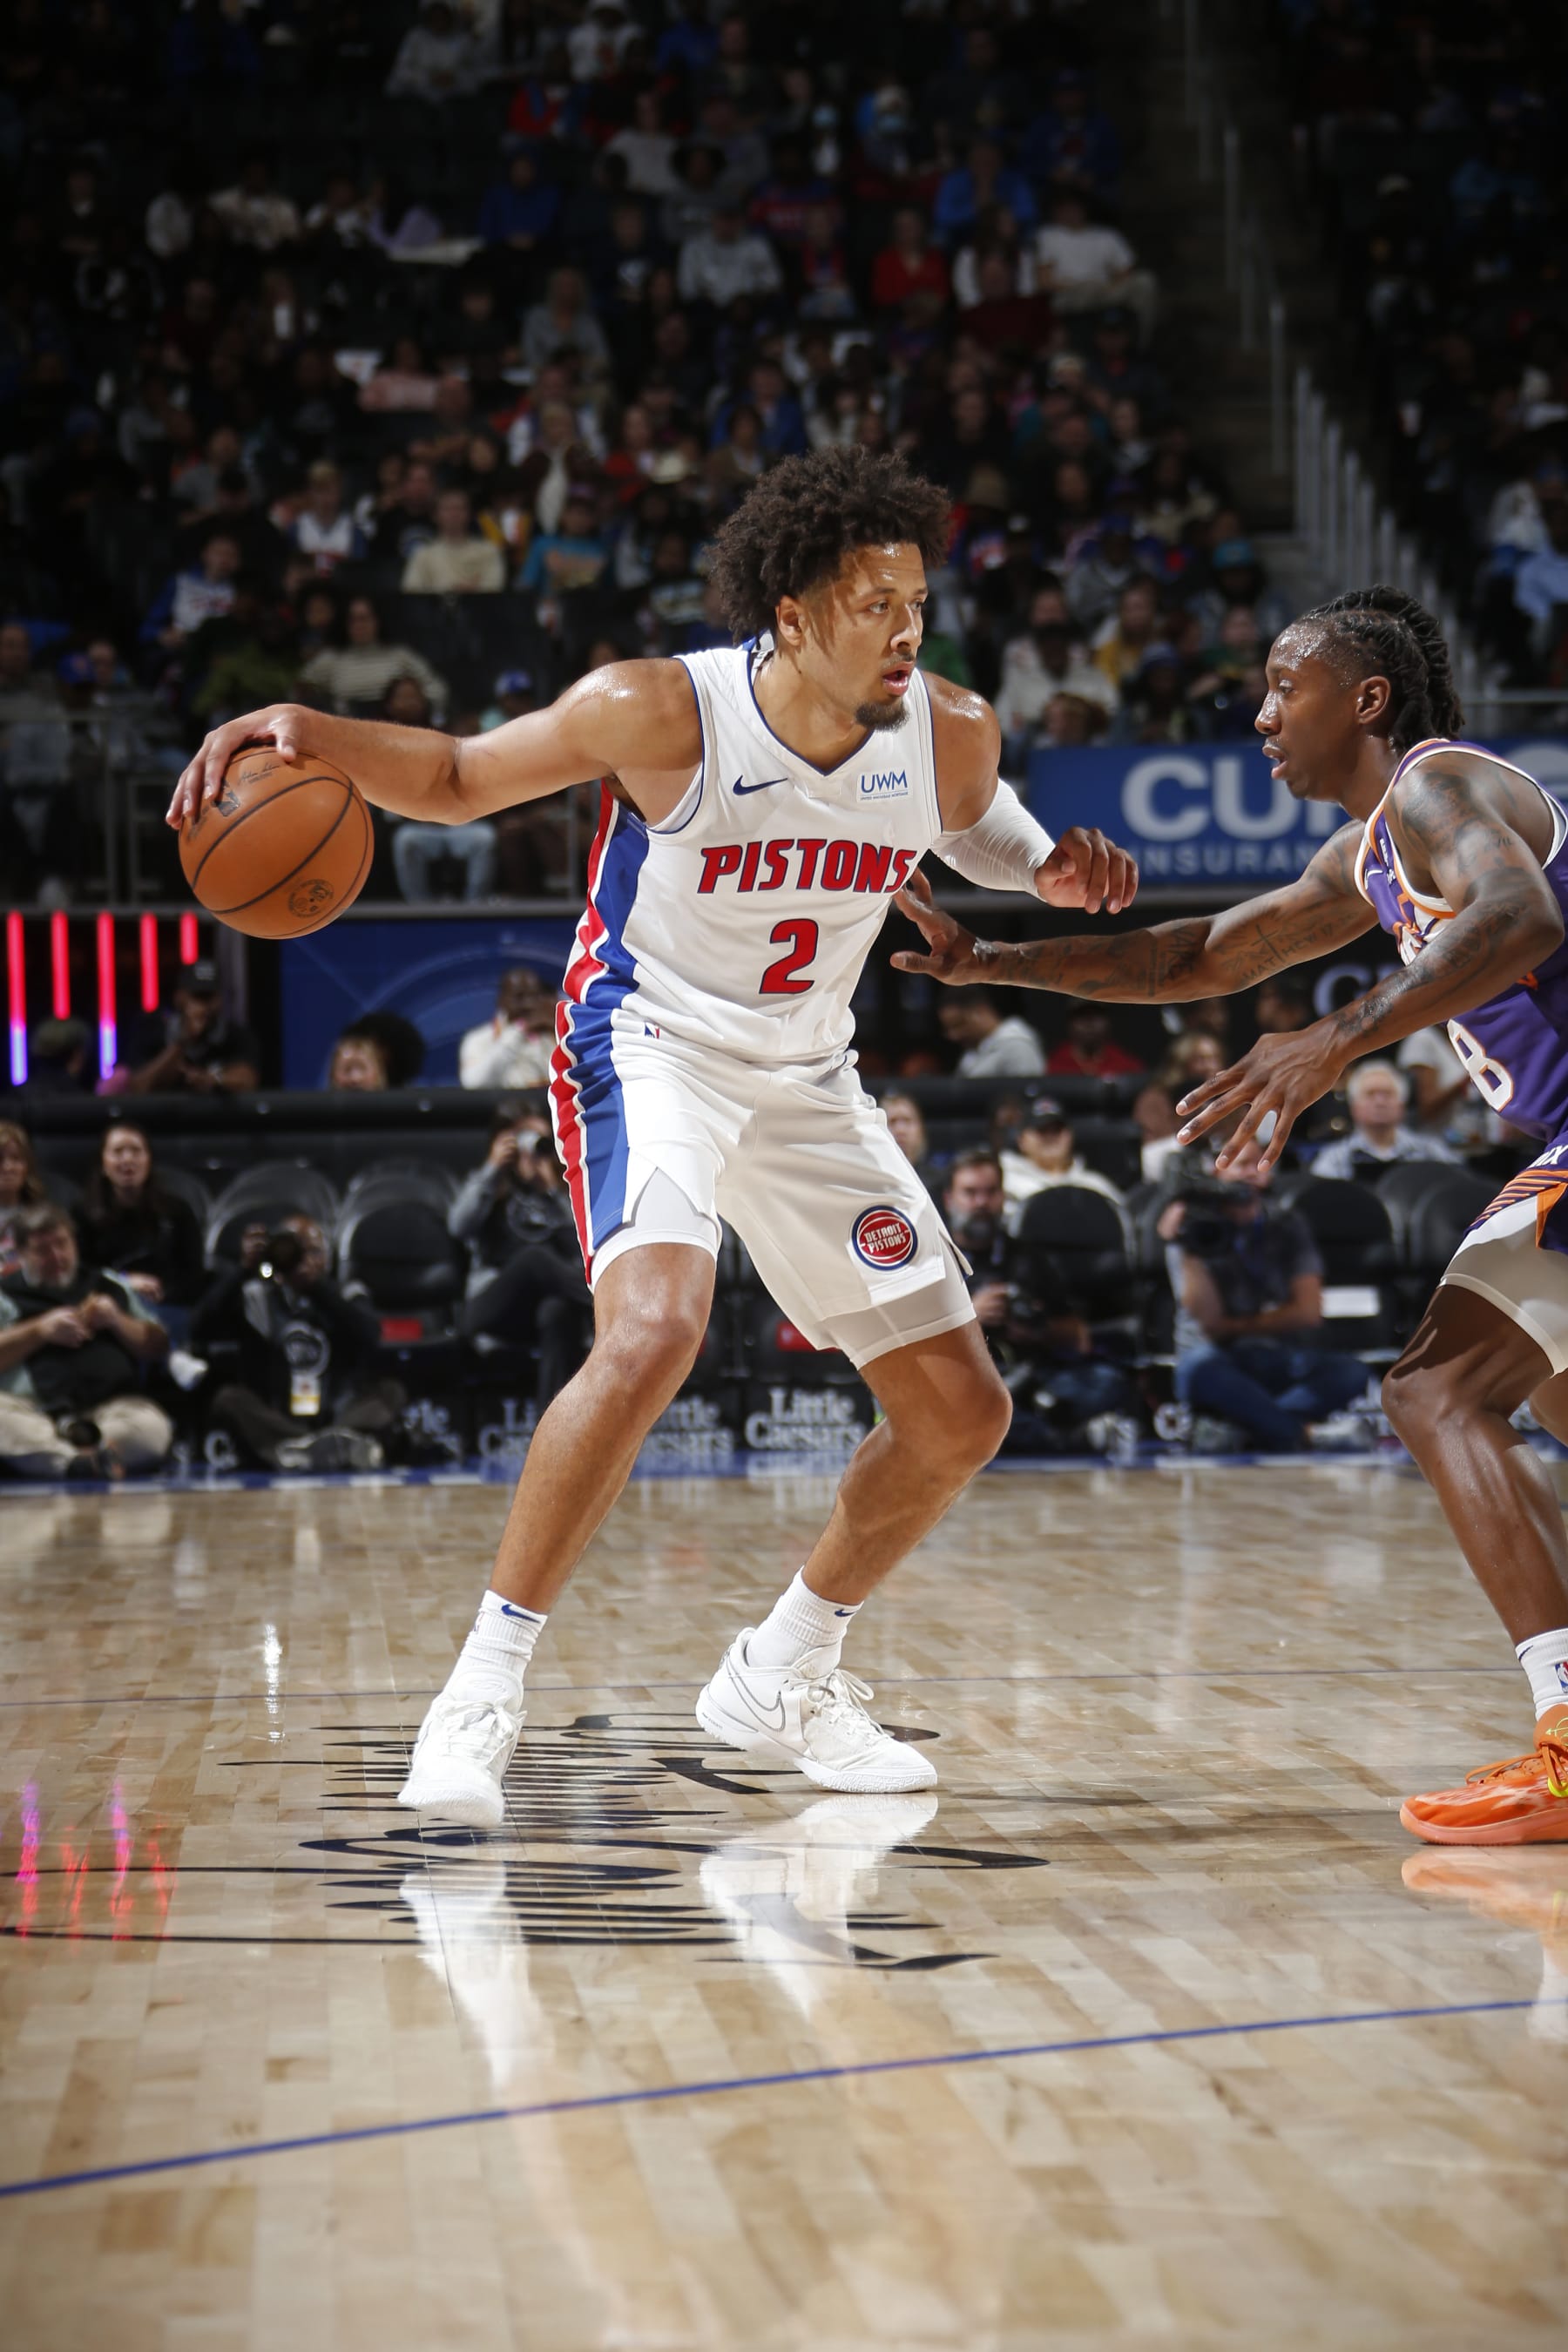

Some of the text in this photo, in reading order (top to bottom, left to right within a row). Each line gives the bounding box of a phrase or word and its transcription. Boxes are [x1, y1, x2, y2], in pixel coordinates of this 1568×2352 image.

[861, 769, 908, 794] UWM
[1121, 754, 1338, 841] CU
[697, 838, 917, 895] PISTONS
[759, 917, 819, 995] 2
[864, 1222, 902, 1243] DETROIT
[867, 1233, 907, 1254] PISTONS
[656, 1395, 720, 1428] ttle
[767, 1387, 855, 1424] Little
[640, 1427, 734, 1458] esars
[744, 1411, 866, 1450] Caesars
